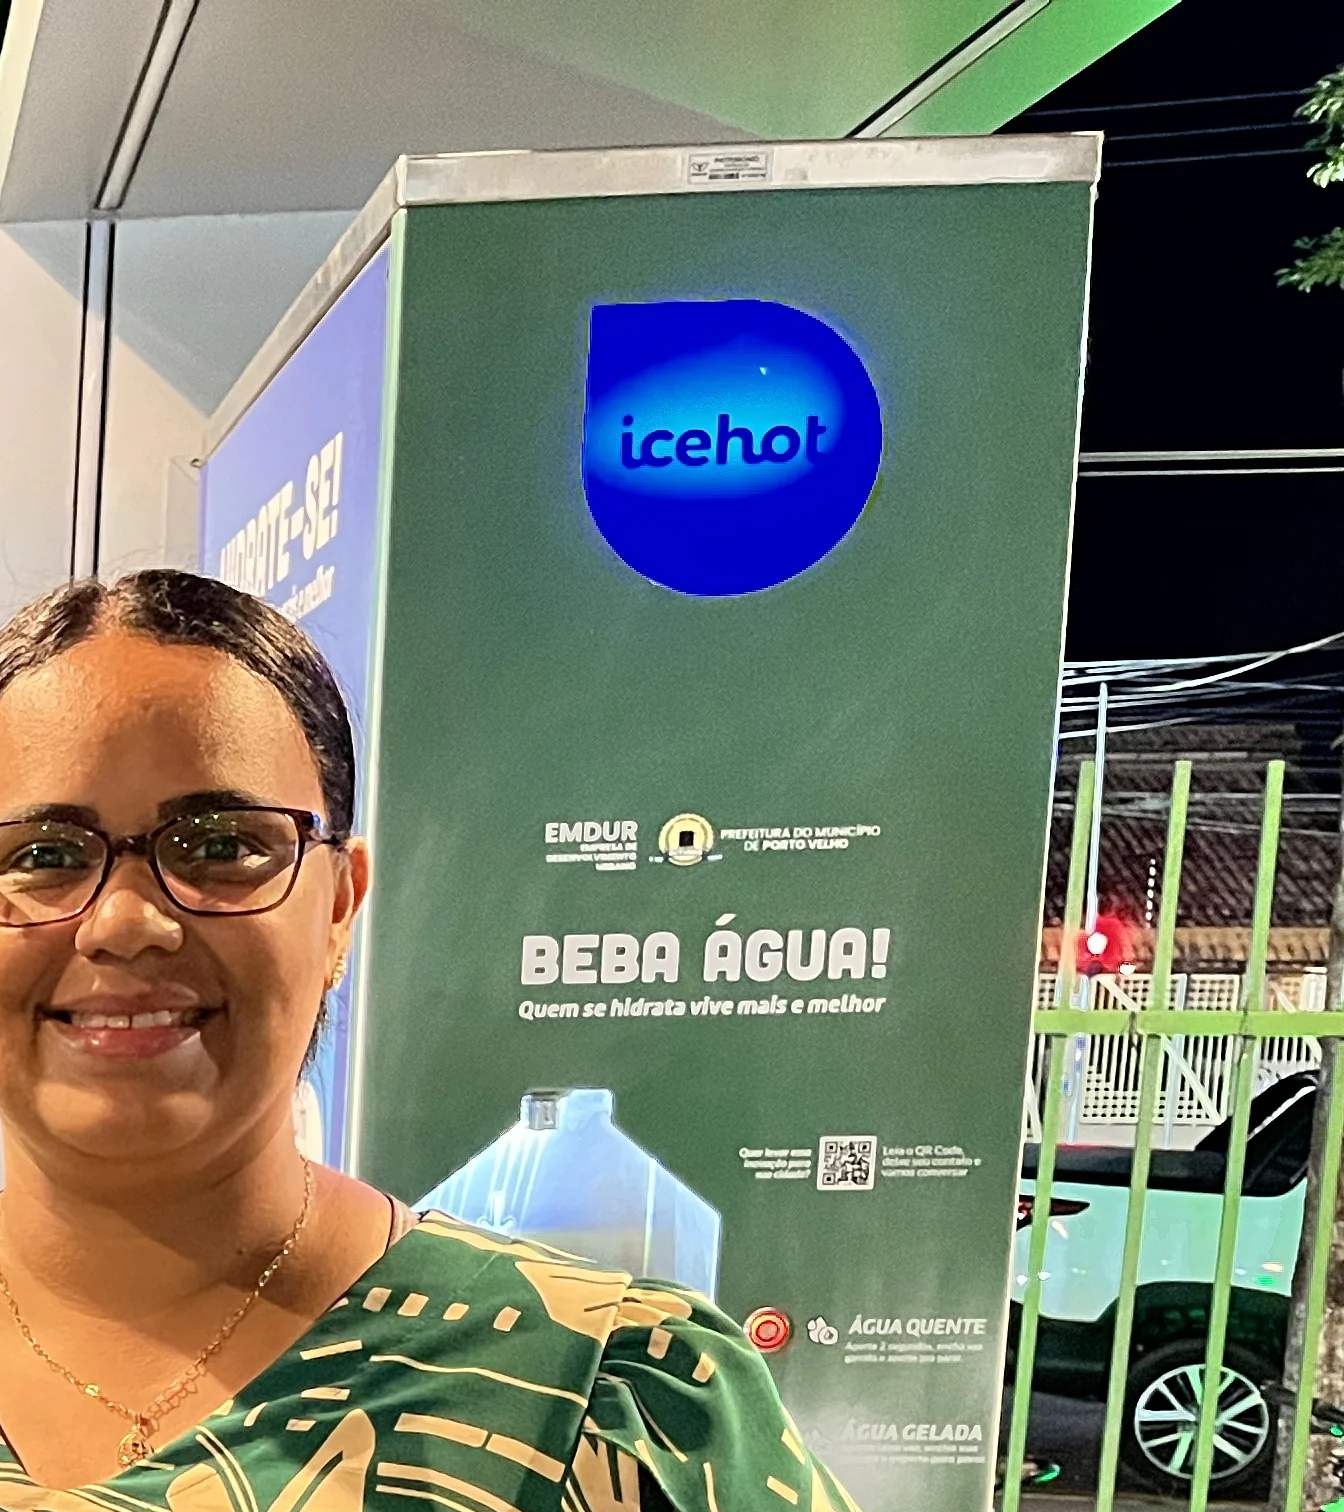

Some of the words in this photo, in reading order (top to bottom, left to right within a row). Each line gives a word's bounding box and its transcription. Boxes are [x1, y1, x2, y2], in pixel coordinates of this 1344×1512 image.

[621, 413, 827, 469] icehot
[544, 820, 639, 844] EMDUR
[720, 827, 791, 840] PREFEITURA
[793, 827, 813, 838] DO
[814, 823, 881, 838] MUNICÍPIO
[743, 839, 759, 852] DE
[762, 838, 807, 851] PORTO
[808, 838, 849, 850] VELHO
[520, 931, 681, 985] BEBA
[703, 913, 891, 982] ÁGUA!
[518, 1000, 580, 1020] Quem
[582, 1001, 607, 1018] se
[610, 997, 687, 1017] hidrata
[690, 995, 734, 1016] vive
[737, 994, 788, 1015] mais
[790, 999, 805, 1014] e
[807, 993, 887, 1014] melhor
[914, 1145, 933, 1156] QR
[848, 1313, 903, 1335] ÁGUA
[906, 1318, 988, 1338] QUENTE
[840, 1418, 899, 1441] ÁGUA
[902, 1423, 983, 1441] GELADA
